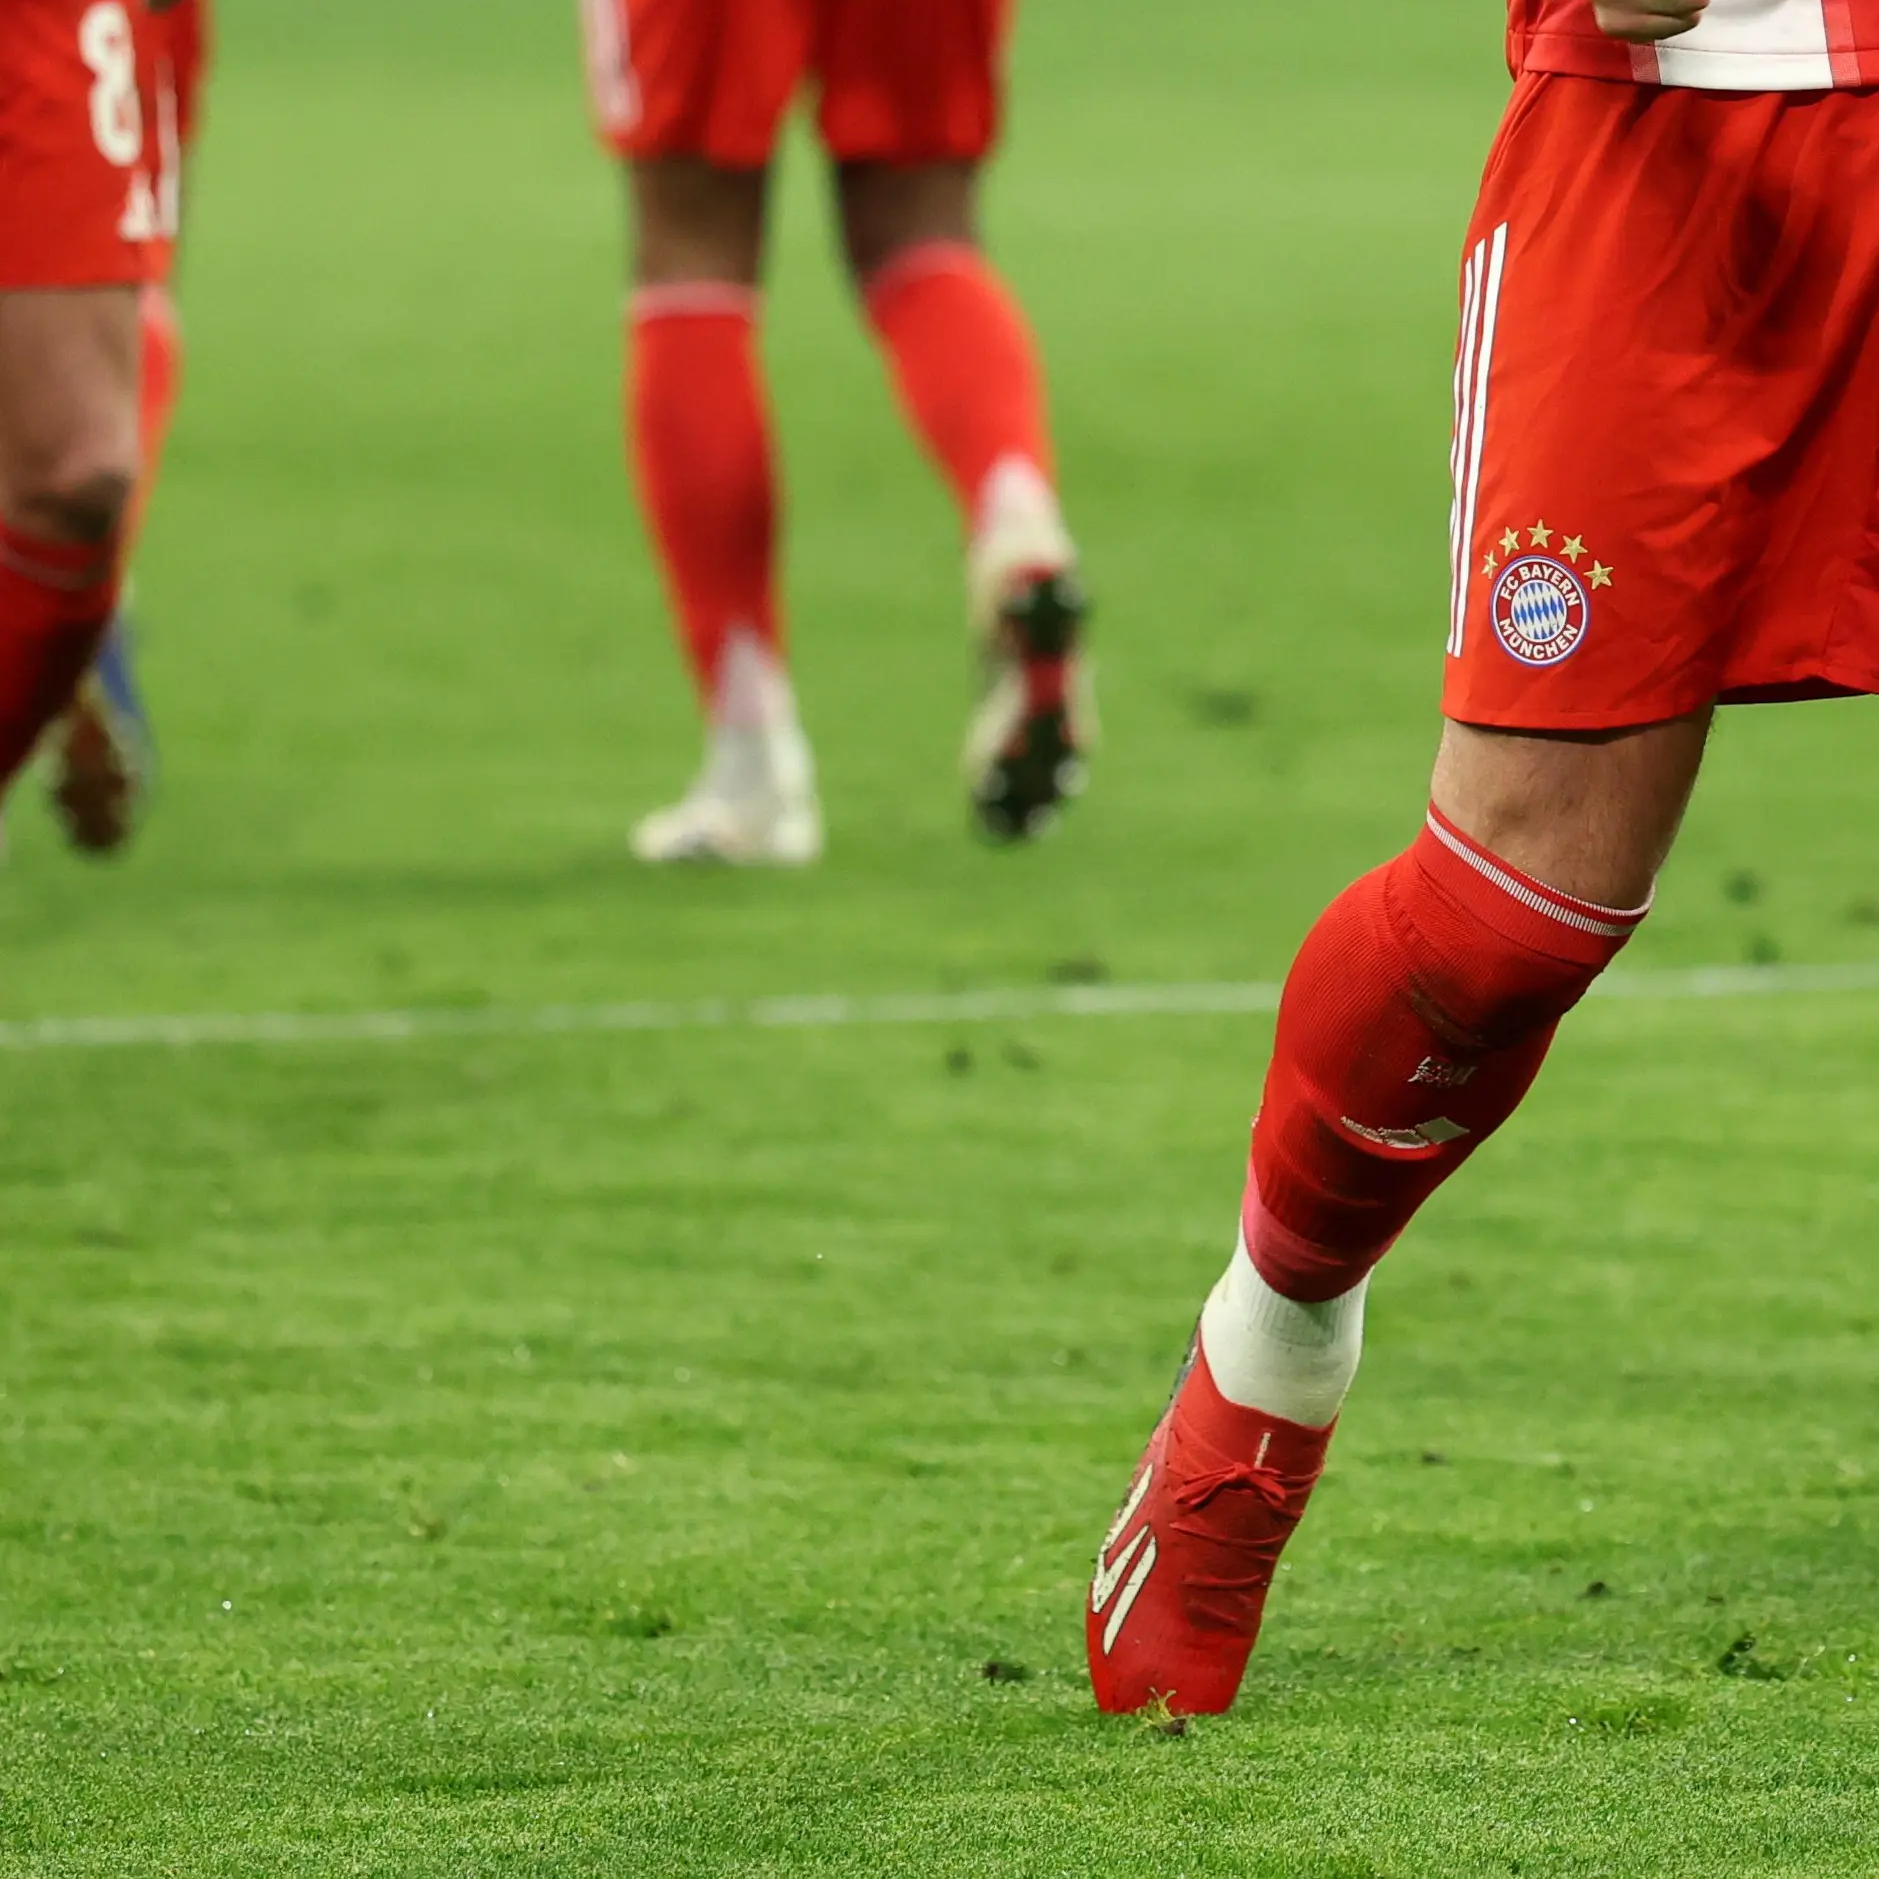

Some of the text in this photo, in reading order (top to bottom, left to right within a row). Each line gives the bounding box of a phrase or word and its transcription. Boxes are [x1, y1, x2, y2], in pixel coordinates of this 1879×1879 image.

[1500, 564, 1580, 607] FC BAYERN
[1499, 619, 1578, 659] MÜNCHEN
